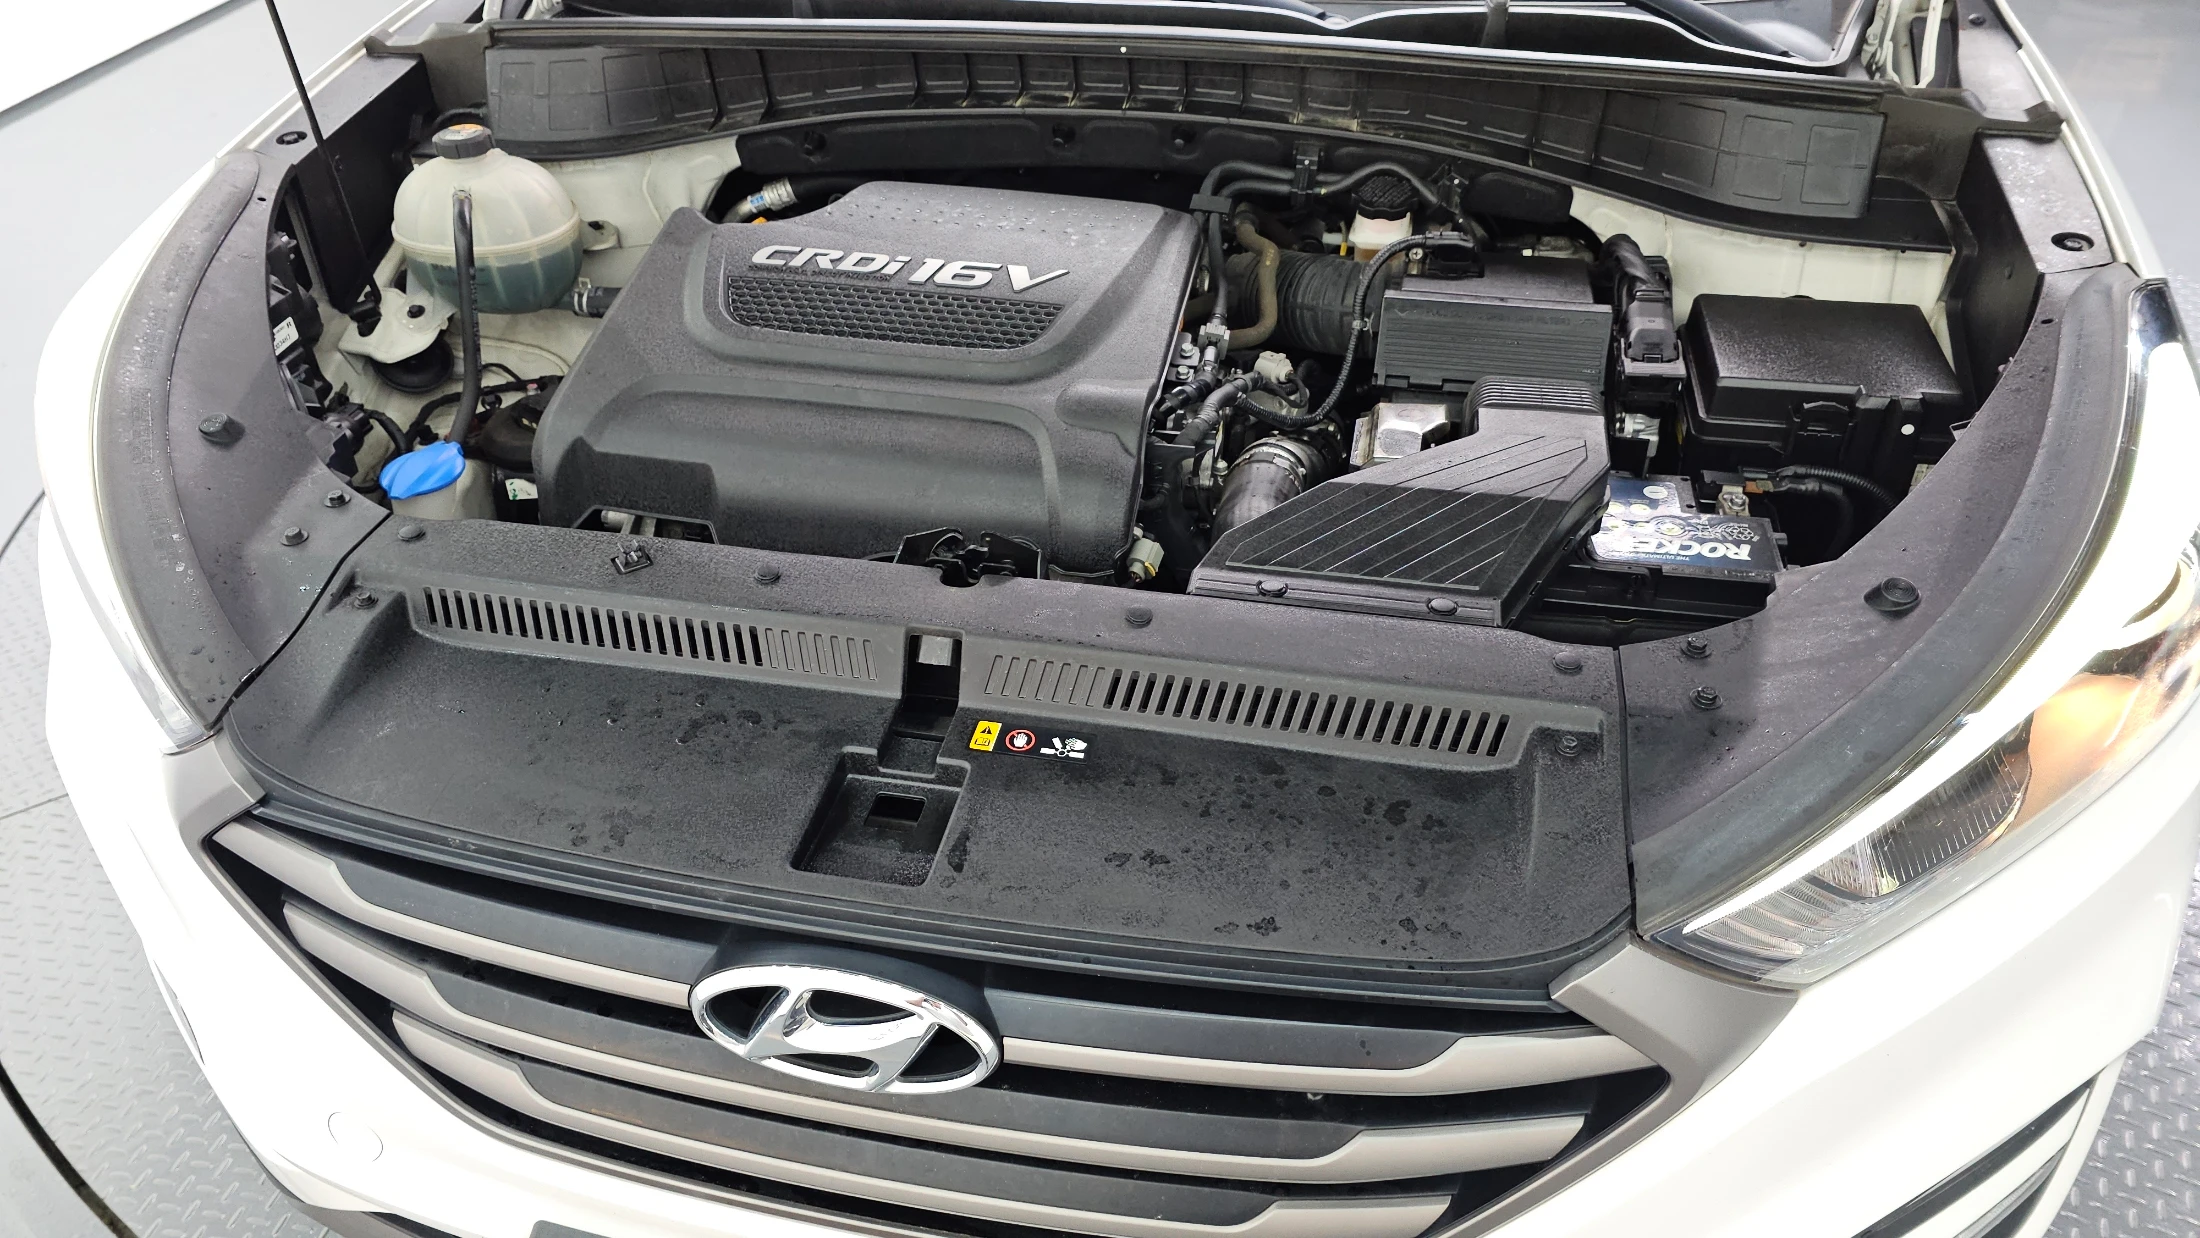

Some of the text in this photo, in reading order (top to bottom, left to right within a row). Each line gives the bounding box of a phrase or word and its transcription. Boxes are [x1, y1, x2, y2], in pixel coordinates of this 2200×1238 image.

[752, 245, 1070, 294] CRDi 16V
[1626, 538, 1752, 561] ROCKE
